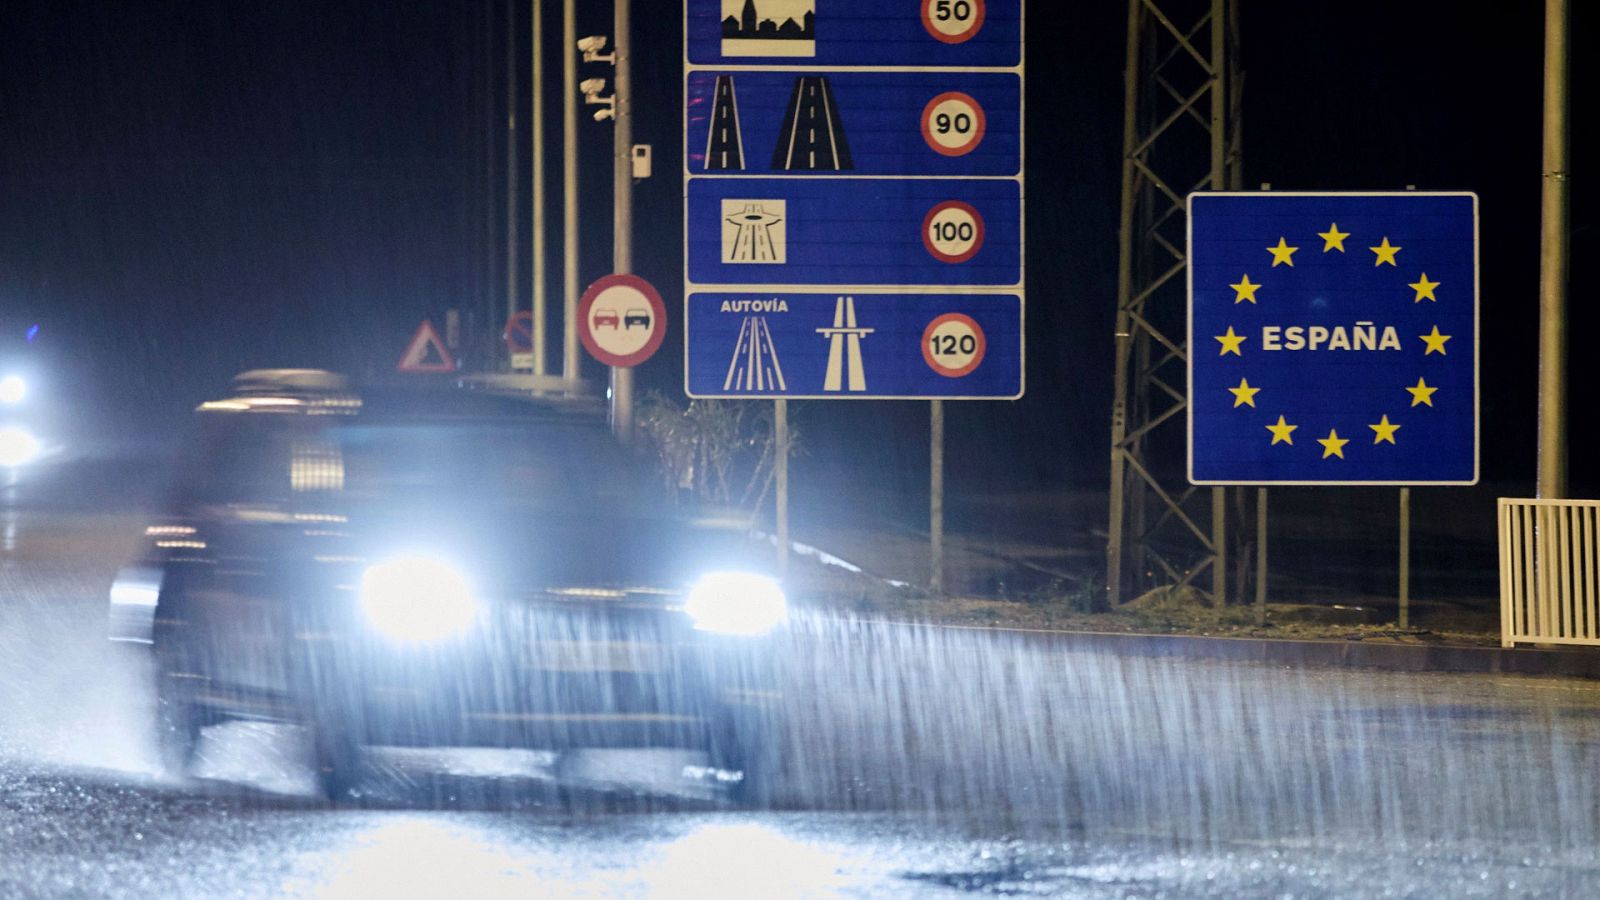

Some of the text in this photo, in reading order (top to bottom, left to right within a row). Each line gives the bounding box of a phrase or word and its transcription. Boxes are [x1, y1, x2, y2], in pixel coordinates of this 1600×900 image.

[936, 0, 970, 21] 50
[936, 113, 971, 134] 90
[933, 222, 973, 242] 100
[720, 298, 789, 313] AUTOVÍA
[931, 334, 976, 355] 120
[1262, 321, 1402, 351] ESPAÑA
